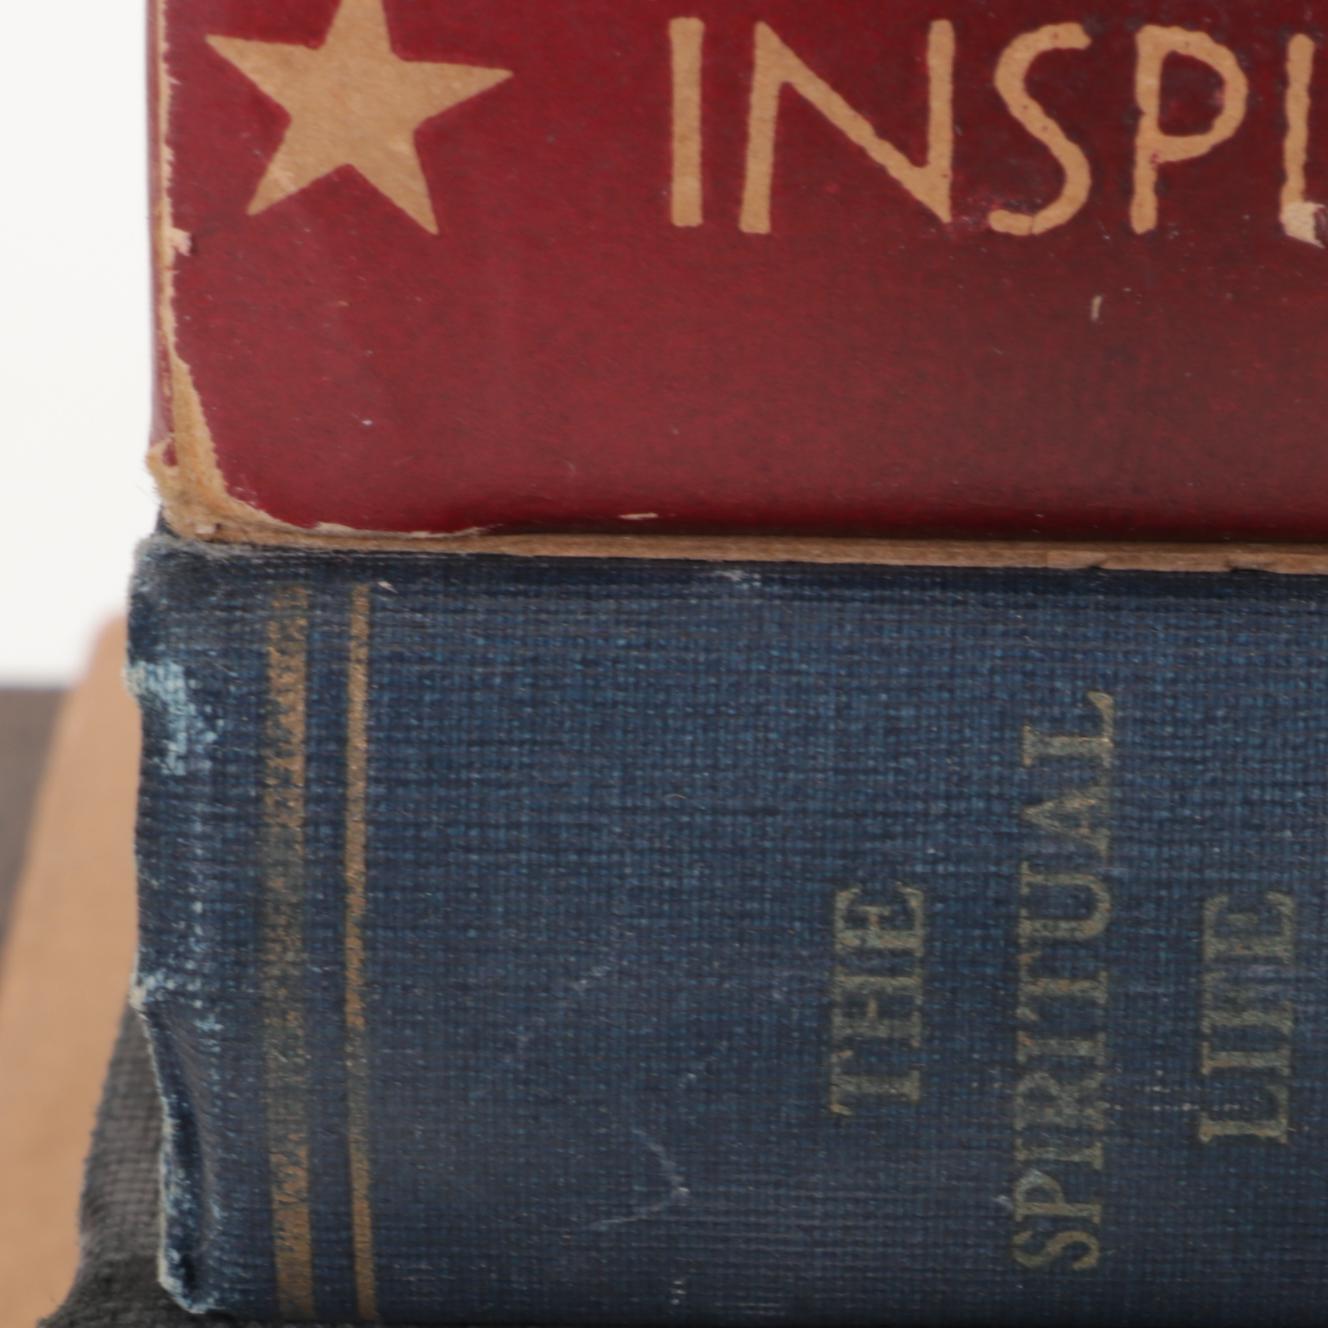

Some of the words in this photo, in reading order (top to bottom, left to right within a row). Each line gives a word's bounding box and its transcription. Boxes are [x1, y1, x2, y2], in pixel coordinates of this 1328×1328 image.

[828, 882, 925, 1118] THE
[1010, 689, 1117, 1273] SPIRITUAL
[1198, 890, 1296, 1146] LIFE
